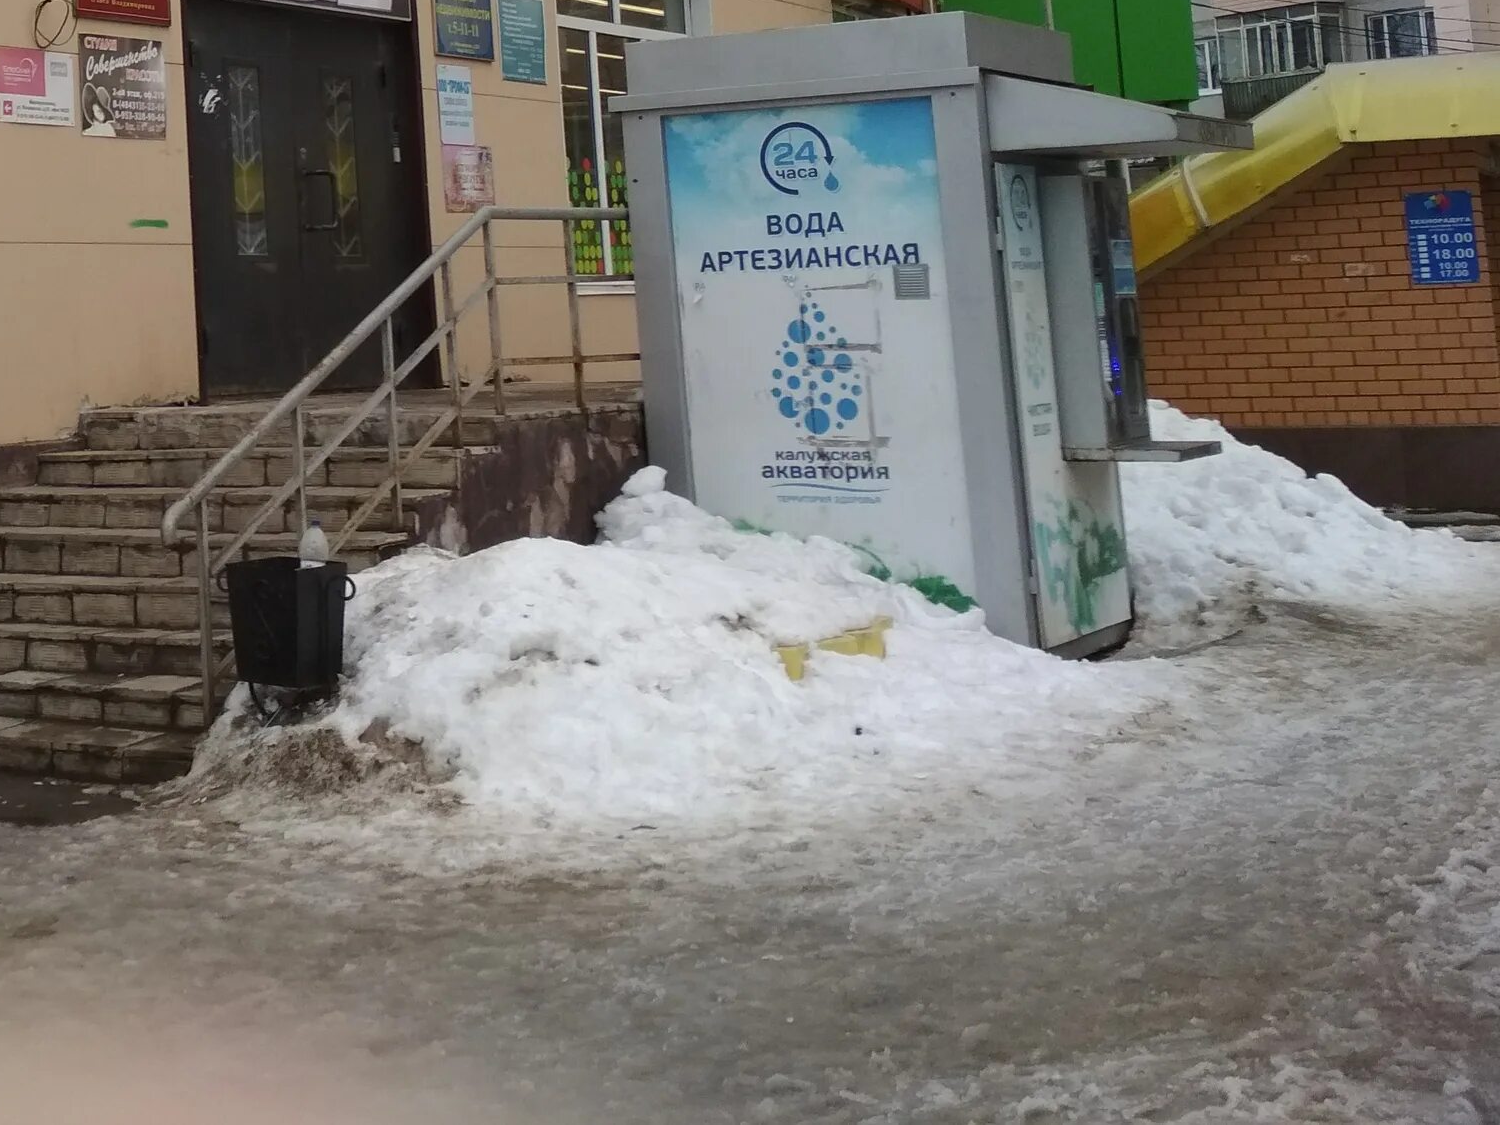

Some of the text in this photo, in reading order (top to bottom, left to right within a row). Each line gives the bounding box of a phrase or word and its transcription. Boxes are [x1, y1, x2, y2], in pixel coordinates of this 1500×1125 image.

[772, 140, 818, 167] 24
[775, 166, 818, 179] часа
[766, 211, 844, 238] ВОДА
[1431, 232, 1473, 244] 10.00
[700, 243, 920, 273] АРТЕЗИАНСКАЯ
[1432, 248, 1475, 260] 18.00
[775, 450, 872, 463] калужская
[762, 465, 890, 483] акватория
